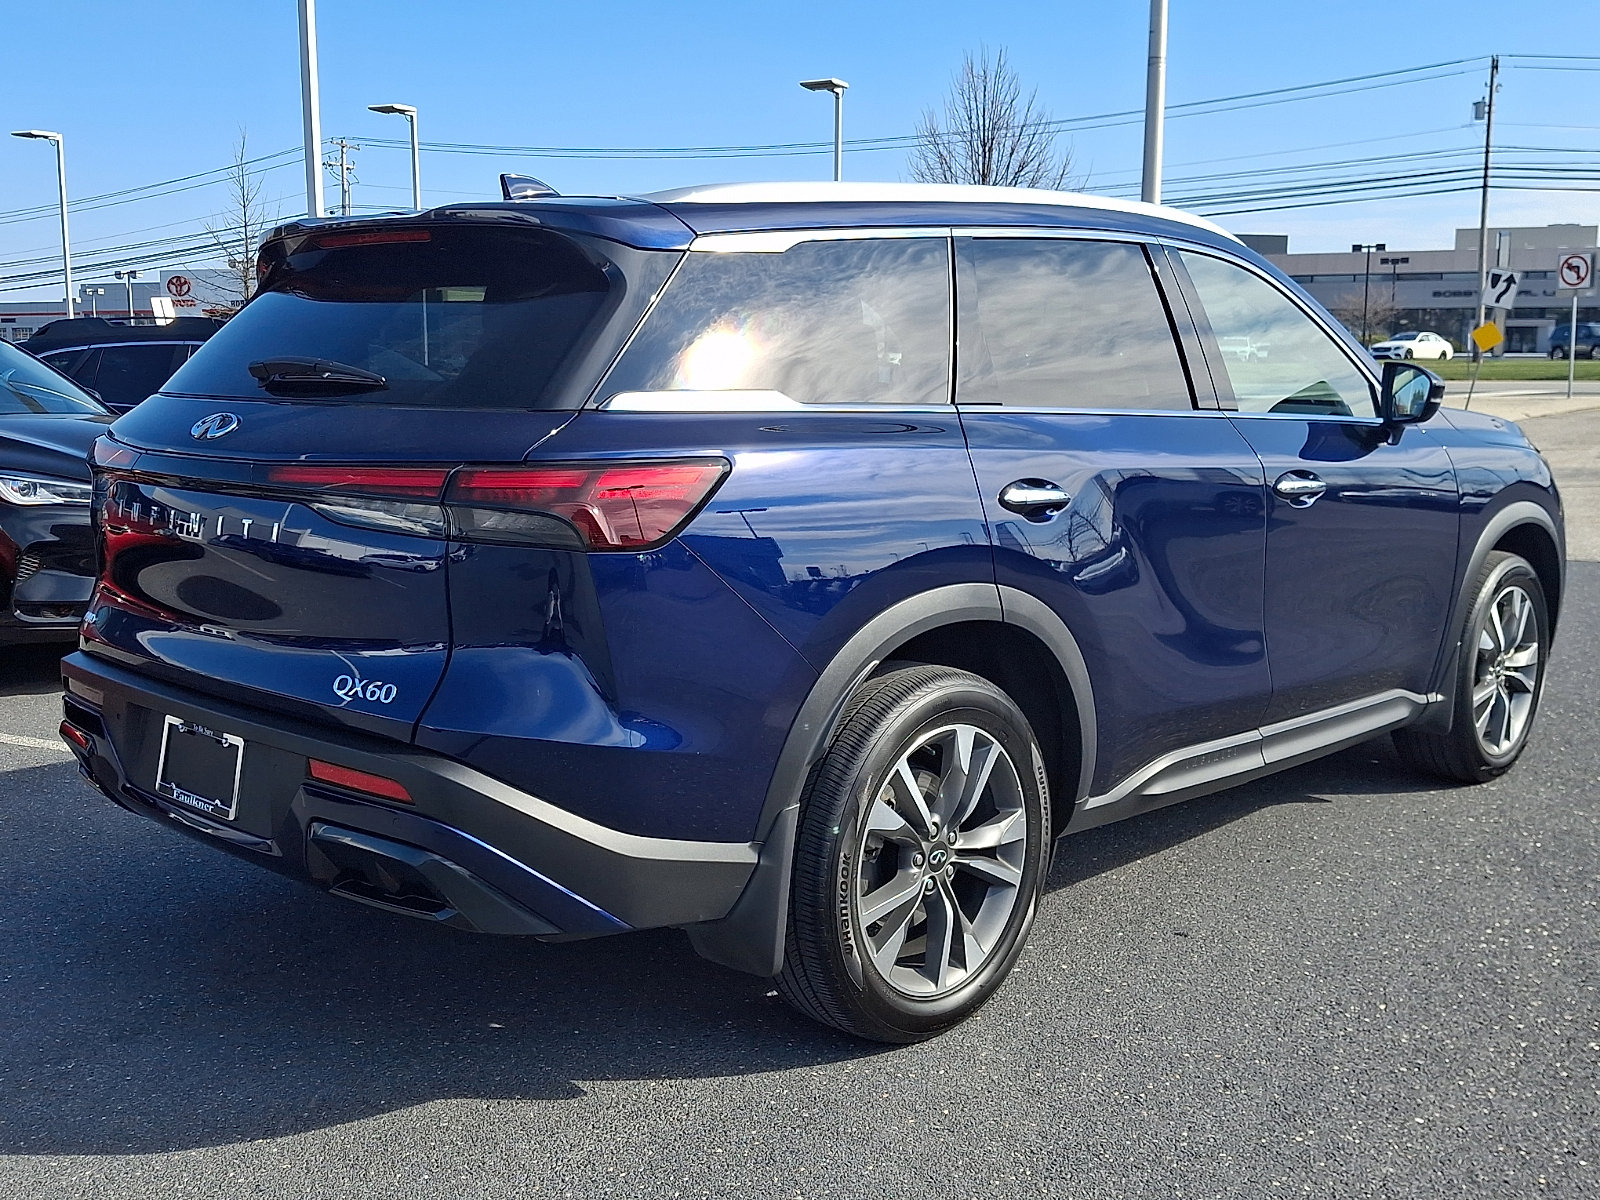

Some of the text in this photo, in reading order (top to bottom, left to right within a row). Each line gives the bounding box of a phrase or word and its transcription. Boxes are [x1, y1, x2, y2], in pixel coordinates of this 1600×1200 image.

[118, 499, 280, 544] INFINITI
[332, 674, 398, 704] QX60
[172, 789, 215, 813] Faulkner
